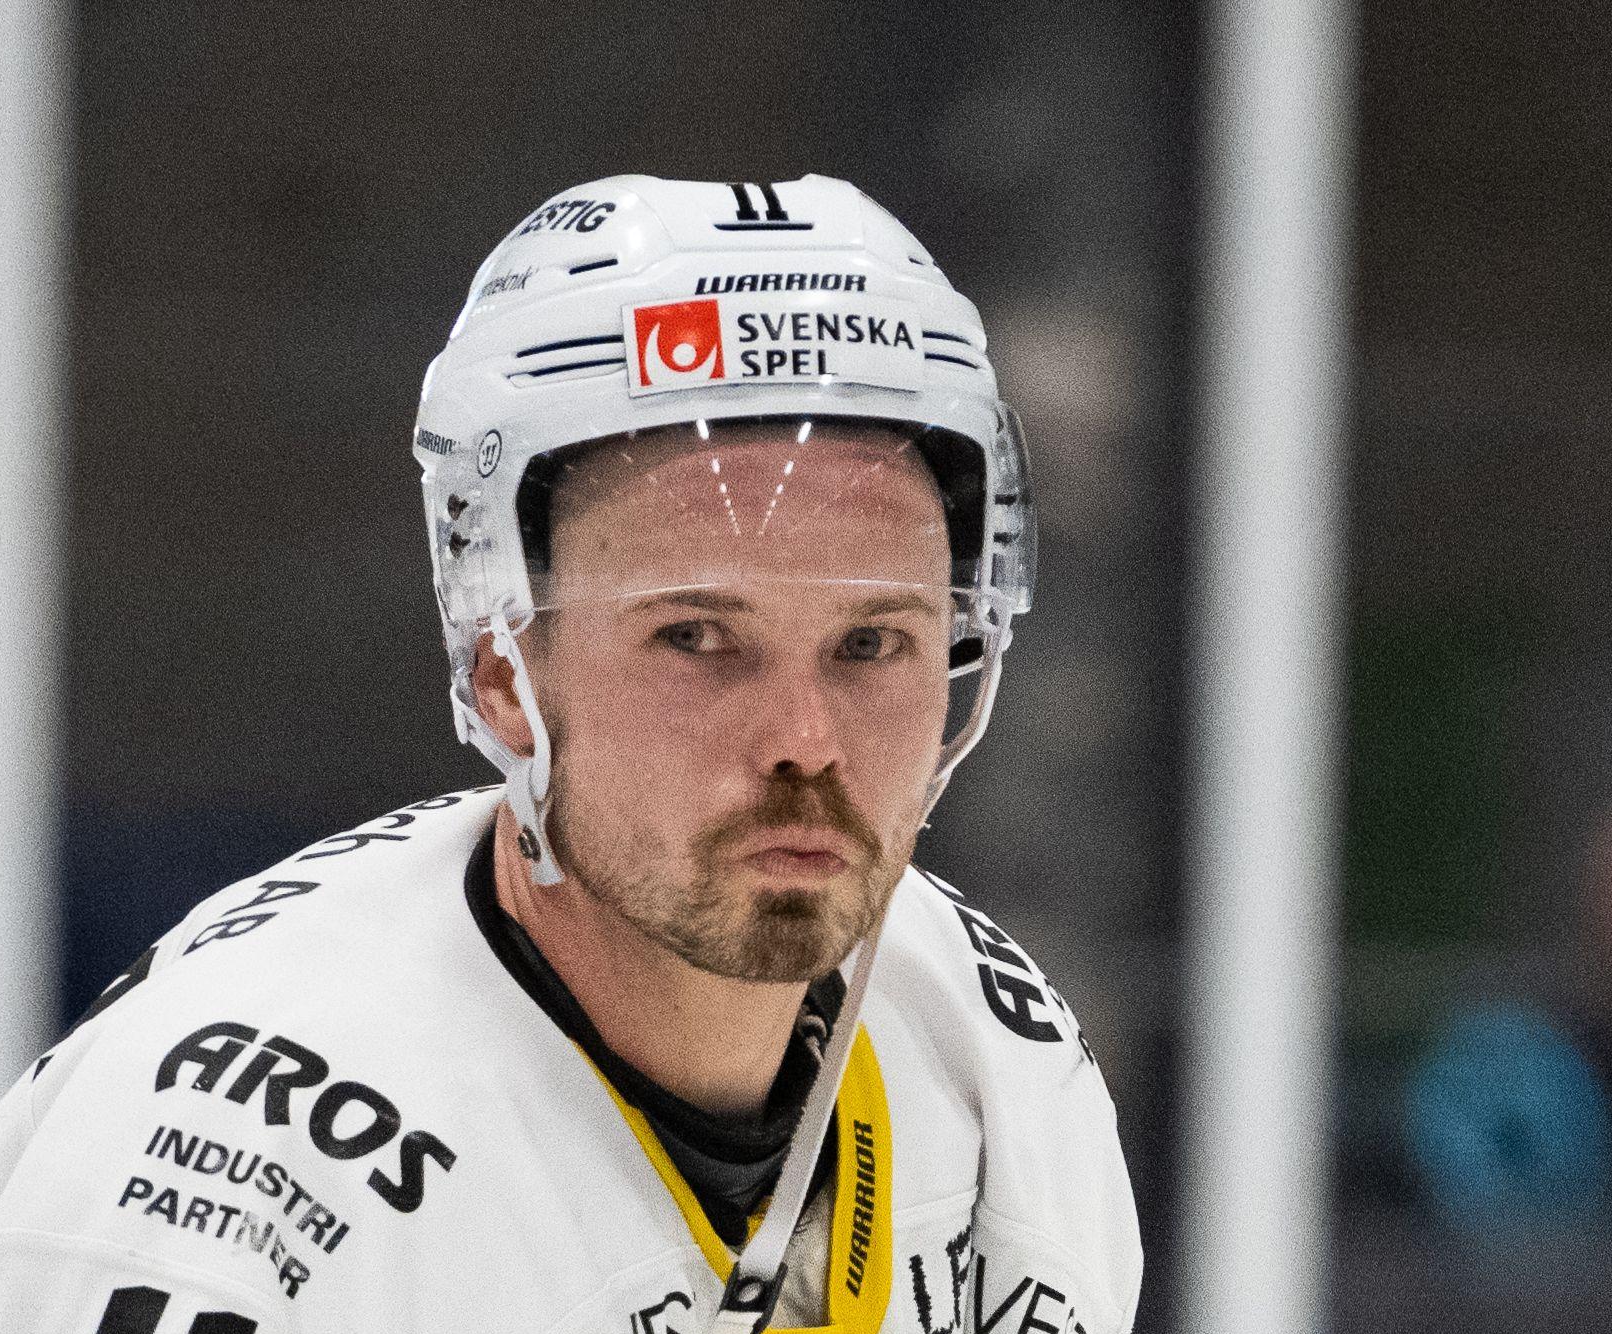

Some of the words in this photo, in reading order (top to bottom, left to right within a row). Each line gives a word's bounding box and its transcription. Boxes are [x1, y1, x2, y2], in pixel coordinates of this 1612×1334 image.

[694, 272, 868, 296] WARRIOR
[736, 312, 917, 351] SVENSKA
[740, 349, 839, 379] SPEL
[154, 1020, 457, 1214] AROS
[117, 1175, 311, 1300] PARTNER
[144, 1125, 351, 1255] INDUSTRI
[846, 1119, 876, 1299] WARRIOR
